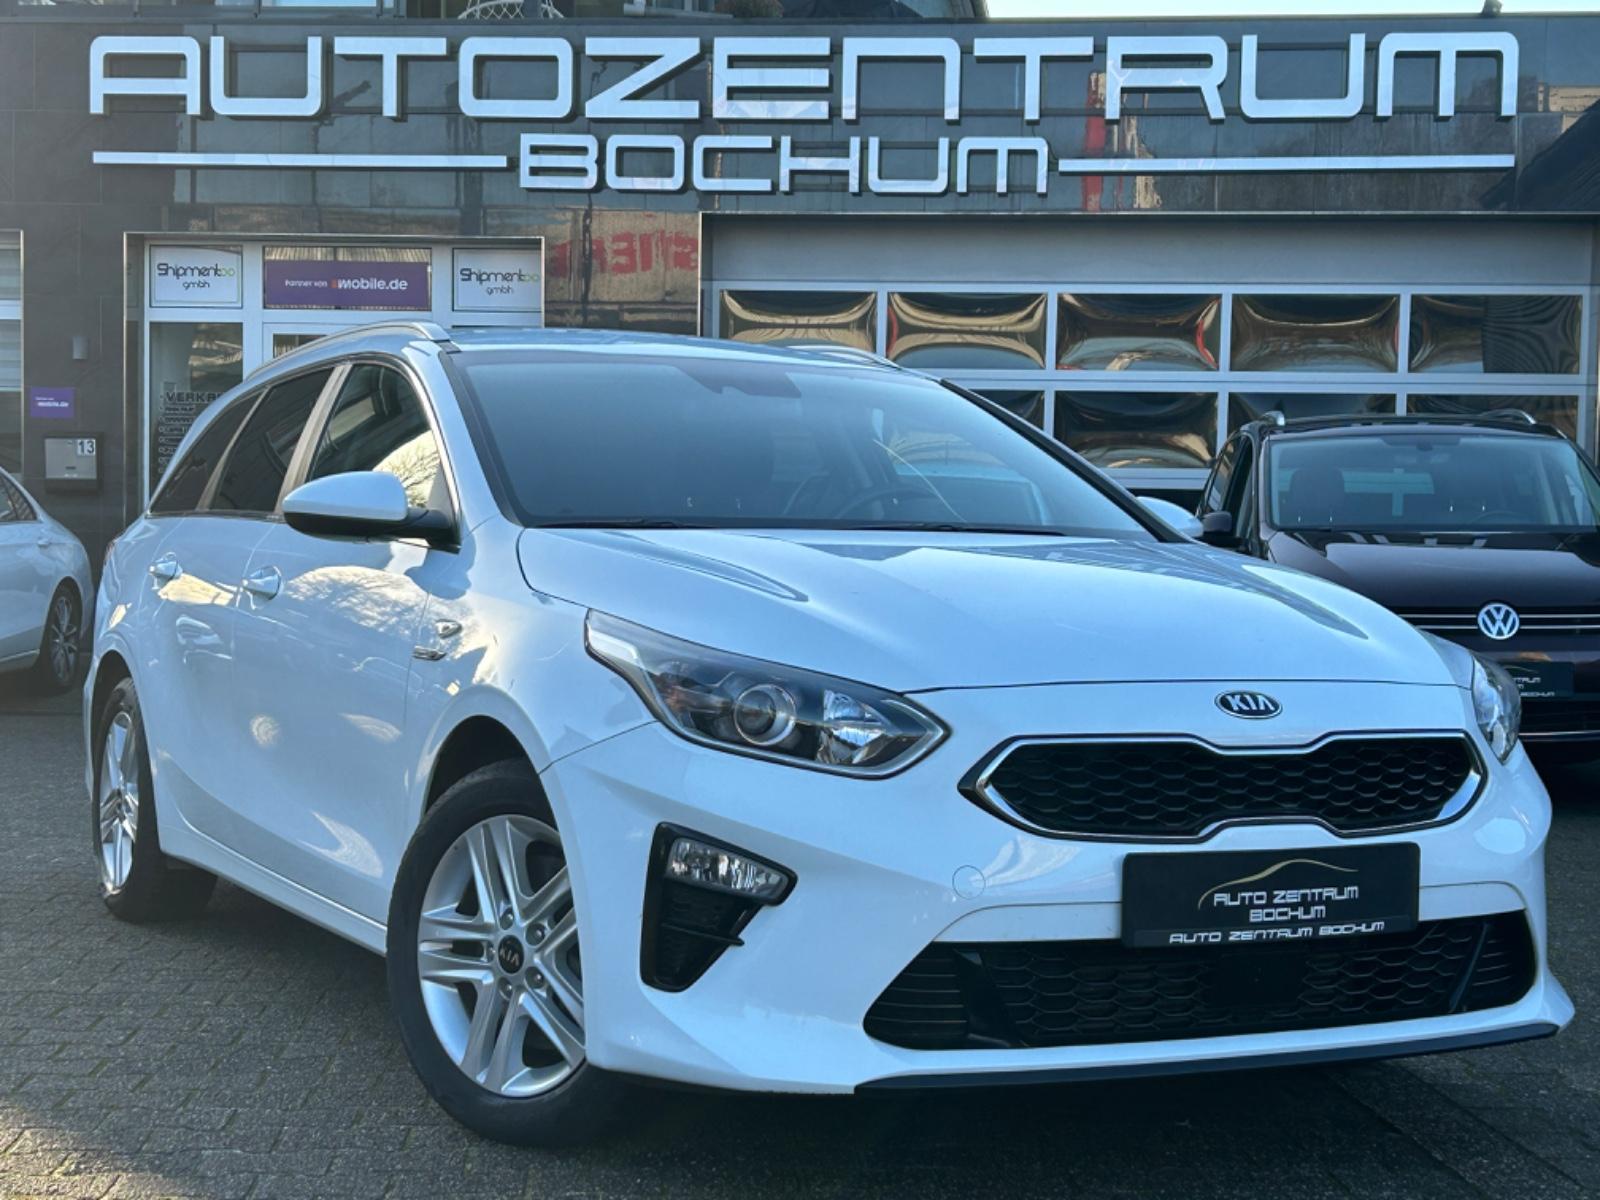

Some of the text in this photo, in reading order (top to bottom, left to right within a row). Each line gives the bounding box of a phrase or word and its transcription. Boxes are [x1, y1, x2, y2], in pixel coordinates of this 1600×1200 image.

[89, 31, 1520, 121] AUTOZENTRUM
[519, 132, 1049, 194] BOCHUM
[337, 277, 408, 290] mobile.de
[79, 440, 95, 454] 13
[1478, 602, 1520, 641] VW
[1224, 694, 1276, 711] KIA
[1213, 885, 1359, 907] AUTO ZENTRUM
[1249, 905, 1326, 922] BOCHUM
[1169, 921, 1385, 944] AUTO ZENTRUM BOCHUM
